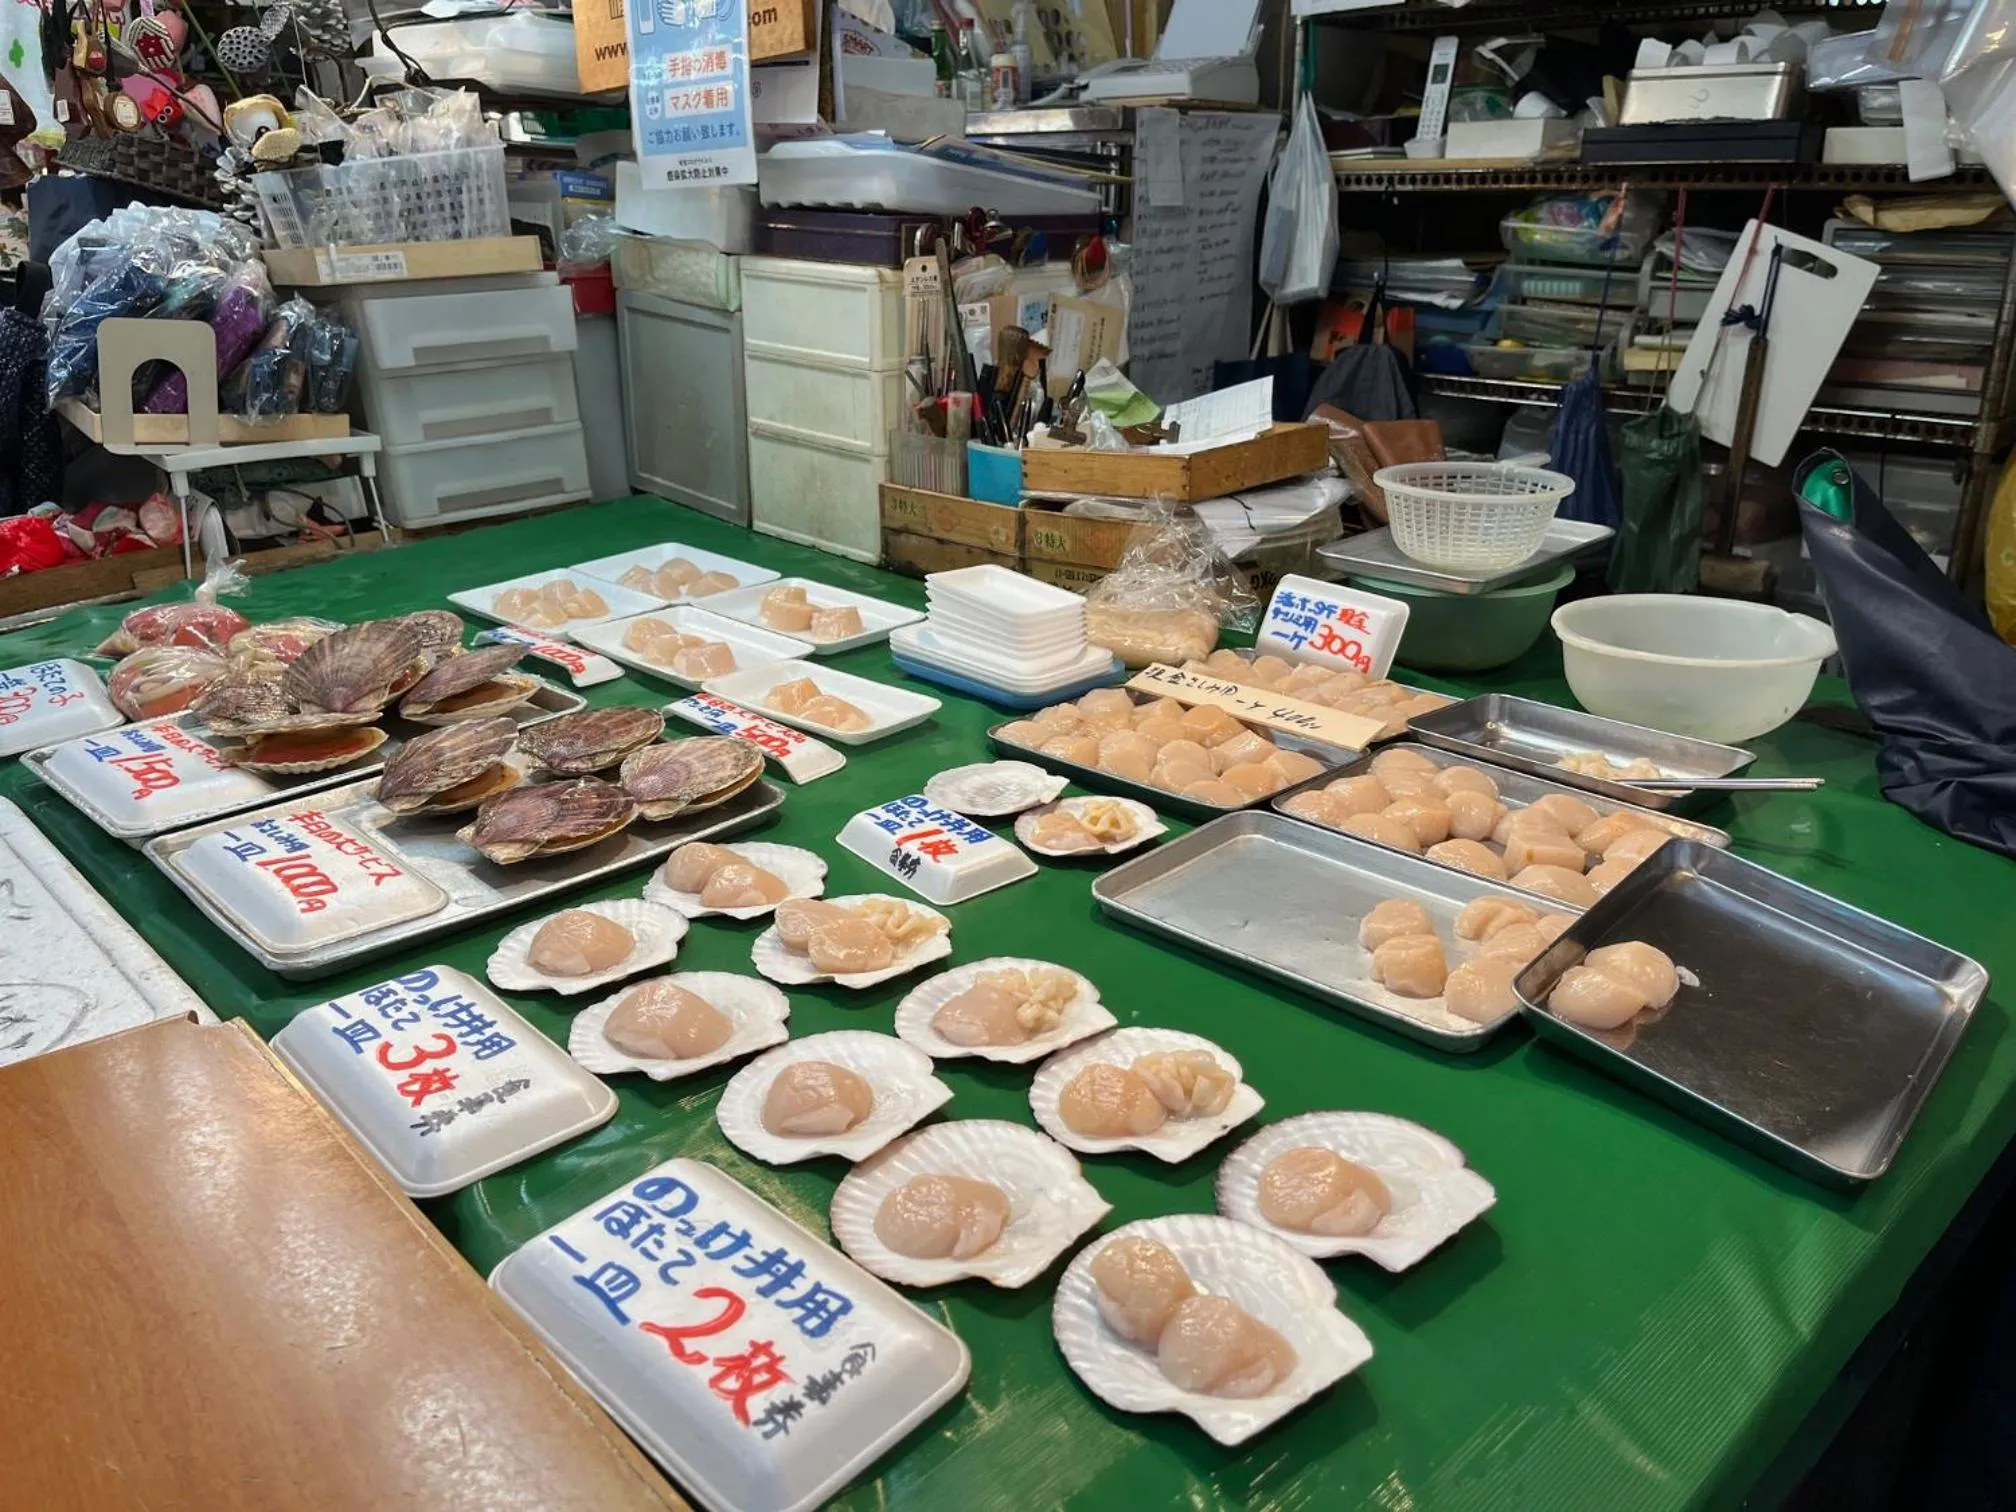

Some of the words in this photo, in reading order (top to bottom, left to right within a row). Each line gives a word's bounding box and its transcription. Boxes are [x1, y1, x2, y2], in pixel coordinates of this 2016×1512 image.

[671, 86, 729, 110] マスク着用
[1309, 624, 1372, 674] 300円
[84, 738, 122, 762] 一皿
[864, 811, 904, 836] 一皿
[881, 802, 925, 829] ほたて
[899, 795, 995, 845] のっけ丼用
[222, 831, 267, 862] 一皿
[359, 983, 421, 1032] ほたて
[393, 969, 518, 1061] のっけ丼用
[328, 1000, 382, 1055] 一皿
[375, 1032, 461, 1108] 3枚
[593, 1200, 696, 1286] ほたて
[632, 1176, 854, 1339] のっけ丼用
[549, 1234, 641, 1327] 一皿
[638, 1286, 798, 1428] 2枚
